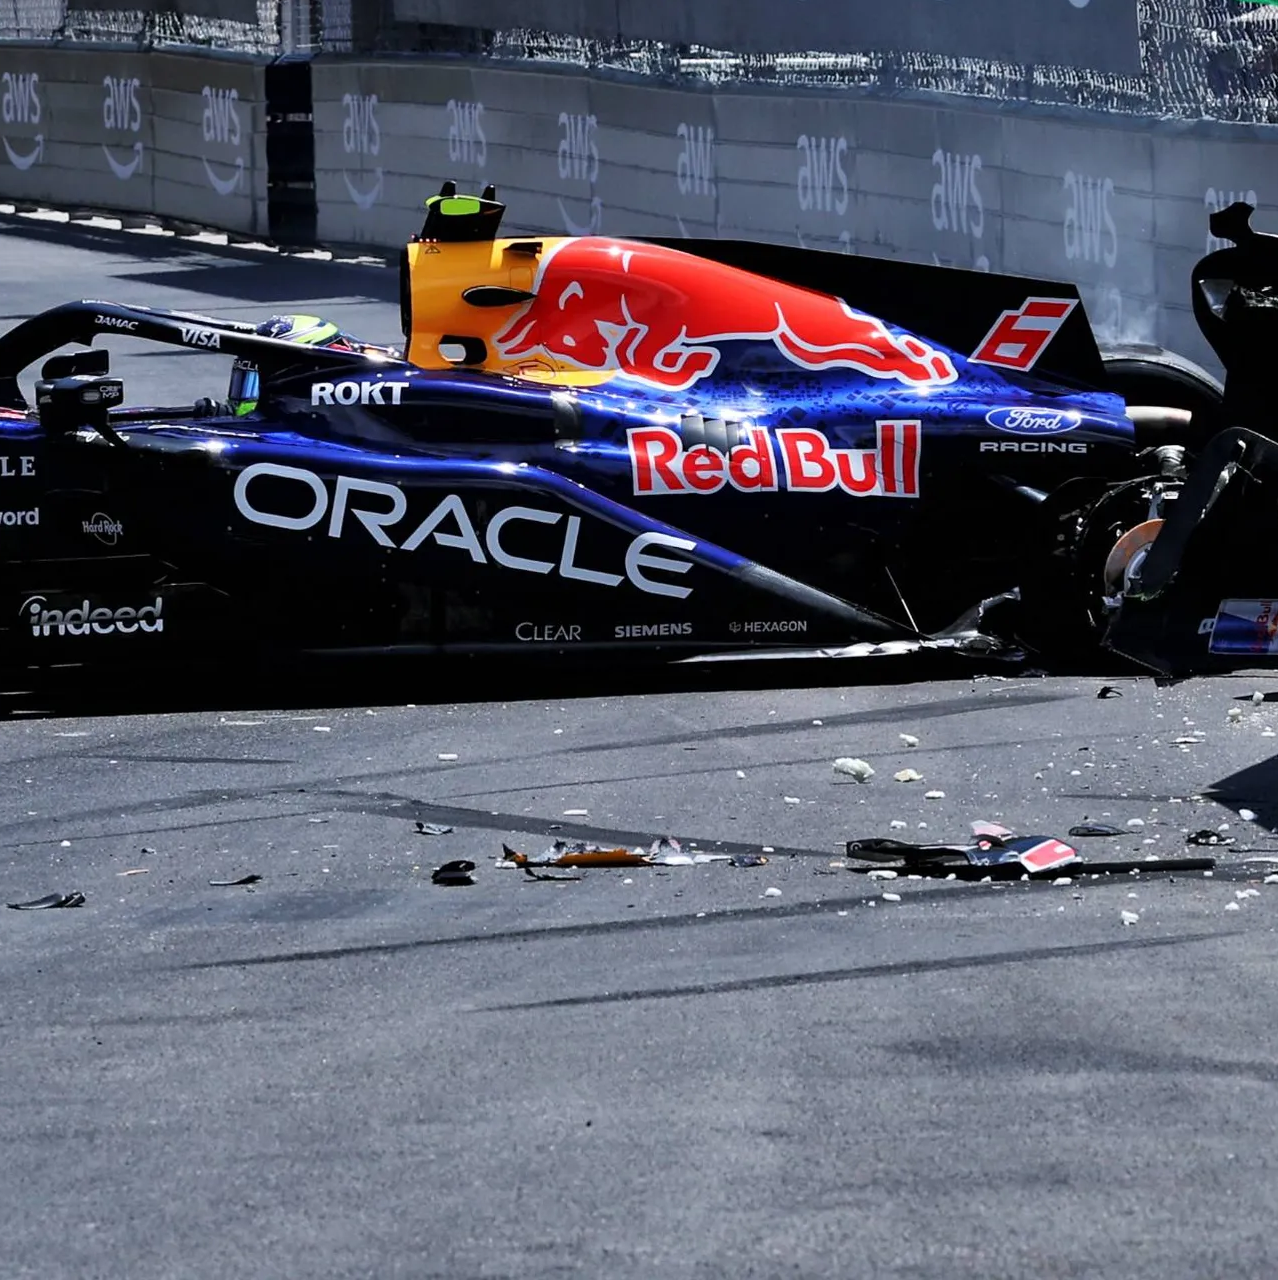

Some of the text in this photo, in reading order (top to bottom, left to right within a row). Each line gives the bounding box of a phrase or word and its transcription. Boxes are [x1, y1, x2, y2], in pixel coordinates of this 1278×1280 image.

[1, 71, 41, 124] aws
[103, 75, 142, 132] aws
[202, 85, 242, 146] aws
[342, 93, 381, 156] aws
[446, 99, 487, 169] aws
[557, 111, 600, 184] aws
[677, 122, 715, 196] aw
[797, 134, 849, 216] aws
[931, 148, 985, 240] aws
[1063, 170, 1119, 269] aws
[179, 326, 221, 348] VISA
[968, 297, 1080, 372] 6
[311, 381, 409, 406] ROKT
[1005, 409, 1062, 429] Ford
[625, 419, 921, 498] Red Bull
[980, 441, 1087, 453] RACING
[82, 520, 123, 536] Hard Rock
[233, 462, 697, 599] ORACLE
[29, 597, 164, 637] indeed
[614, 623, 693, 638] SIEMENS
[744, 621, 808, 632] HEXAGON
